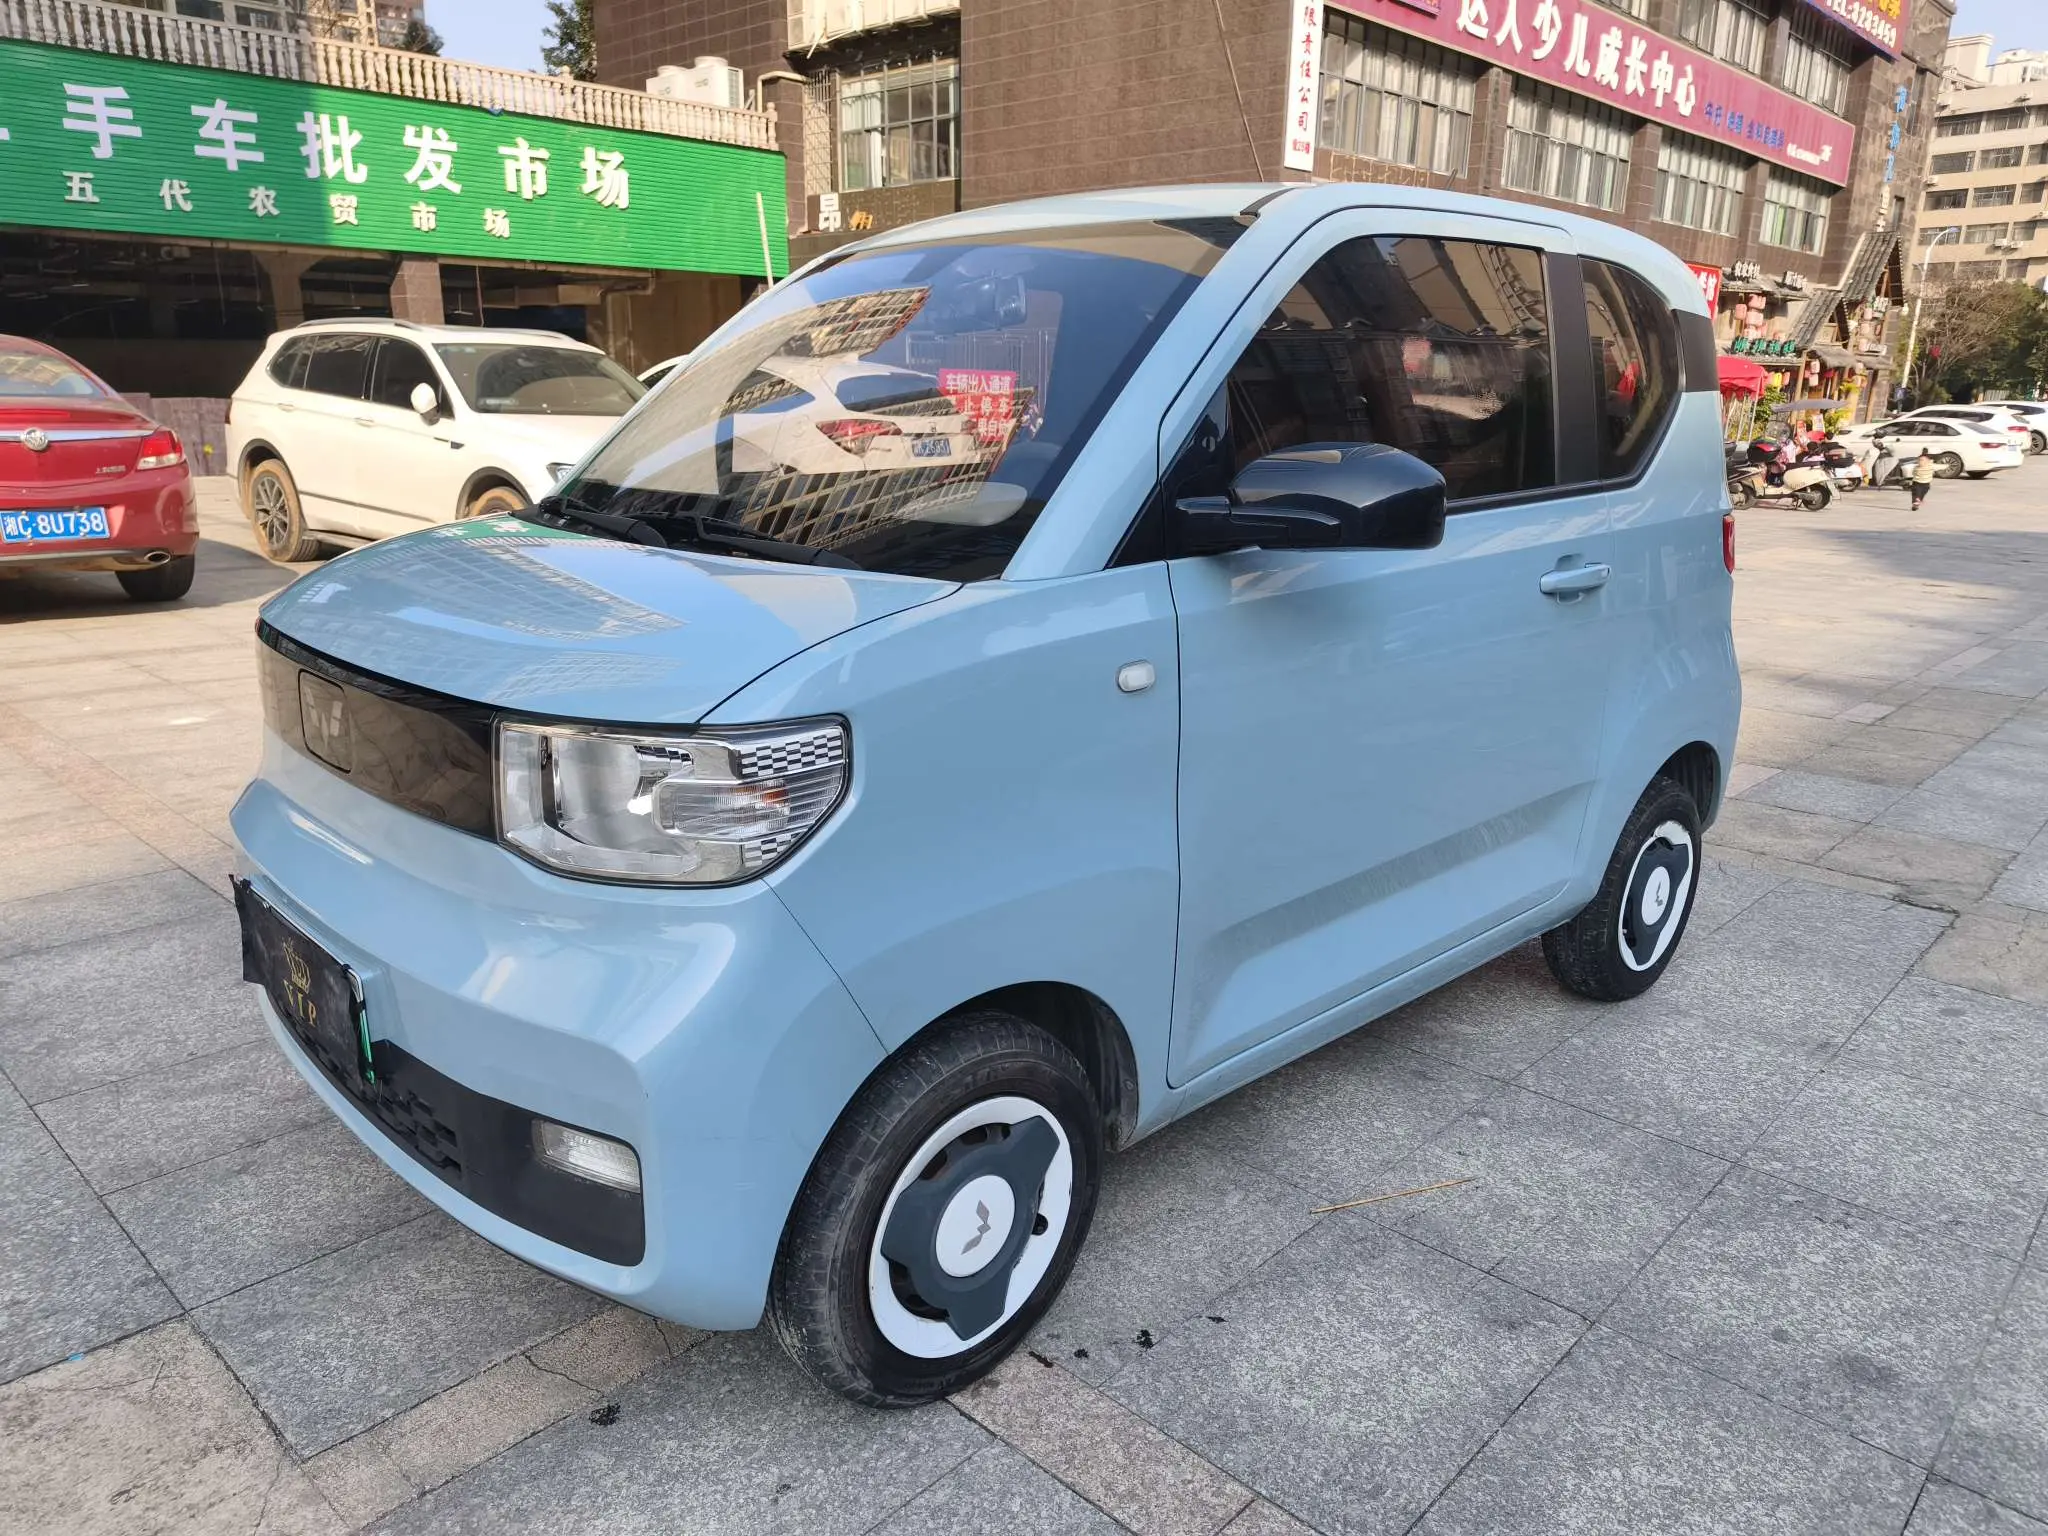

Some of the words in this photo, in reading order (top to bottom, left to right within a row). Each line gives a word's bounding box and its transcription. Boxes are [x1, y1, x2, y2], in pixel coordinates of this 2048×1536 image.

[1297, 0, 1317, 131] 限责任公司
[0, 82, 629, 209] 手车批发市场
[62, 171, 511, 238] 五代农贸市场
[945, 373, 1011, 394] 车辆出入通道
[282, 979, 317, 1028] VIP
